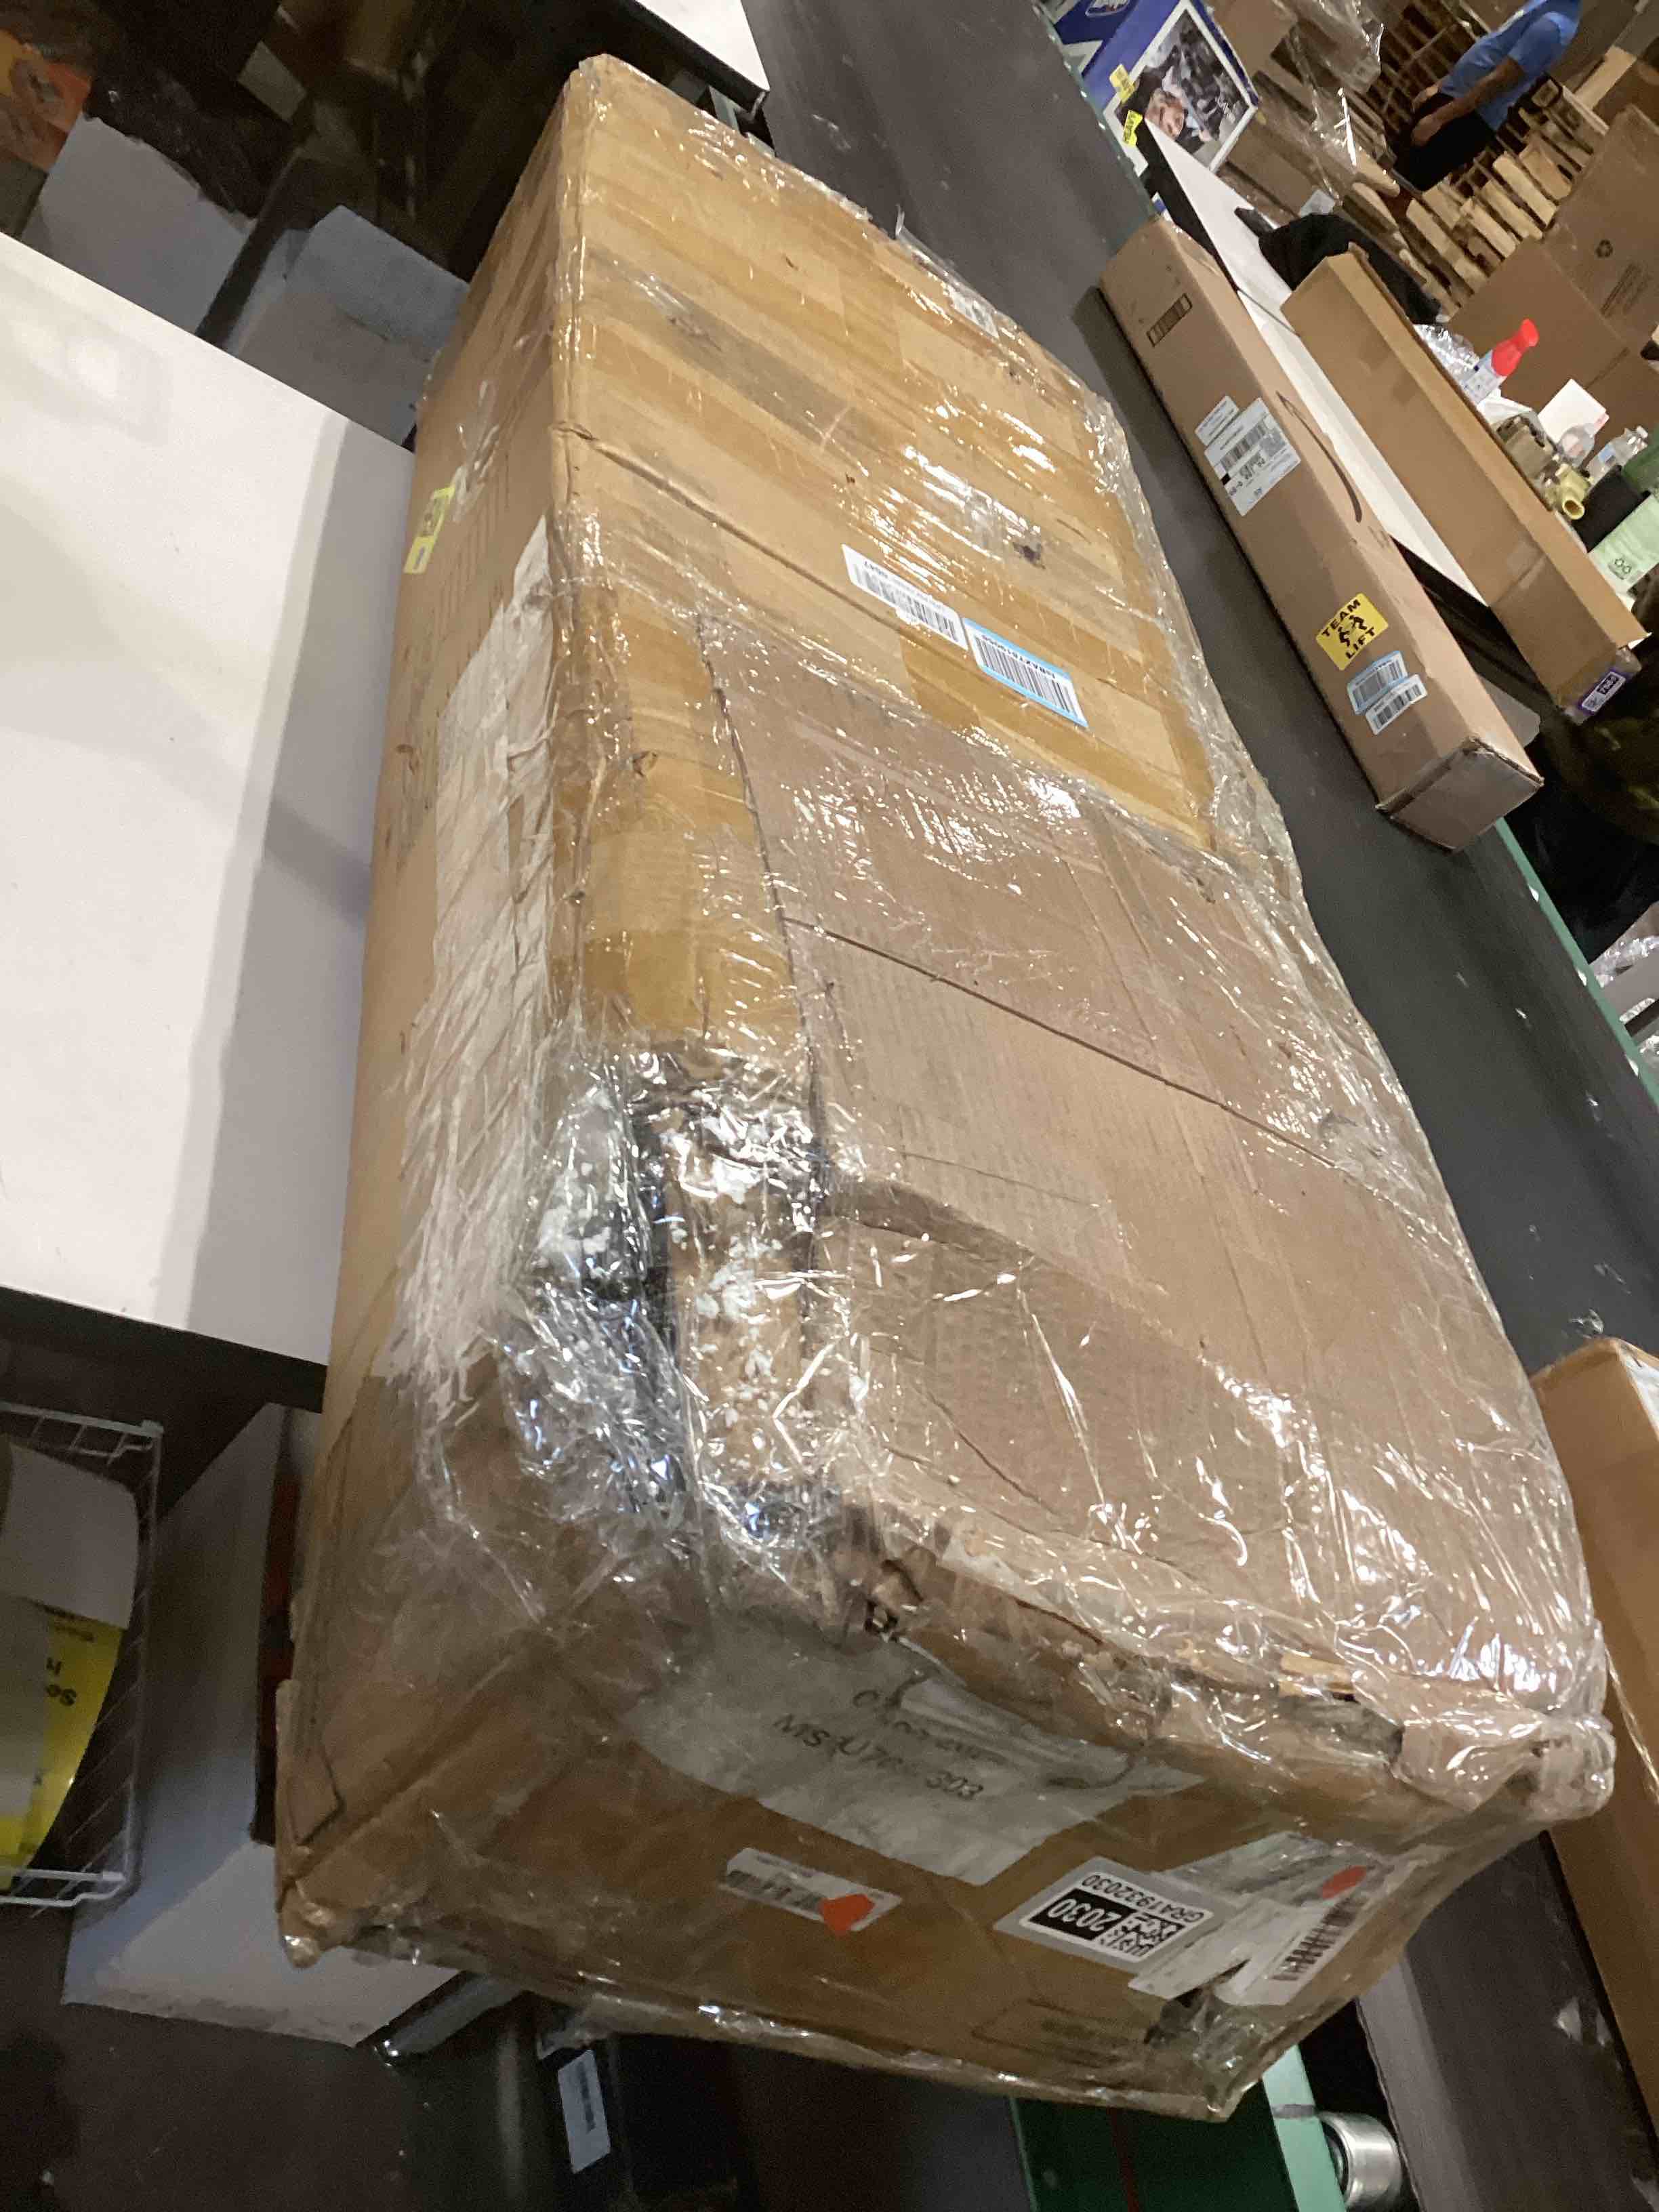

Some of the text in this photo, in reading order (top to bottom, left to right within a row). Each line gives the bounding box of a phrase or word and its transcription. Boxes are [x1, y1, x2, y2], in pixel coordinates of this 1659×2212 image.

[1321, 598, 1361, 637] TEAM
[1345, 626, 1375, 659] LIFT
[1048, 1898, 1122, 1932] 2030
[1082, 1874, 1204, 1923] GRA1932030
